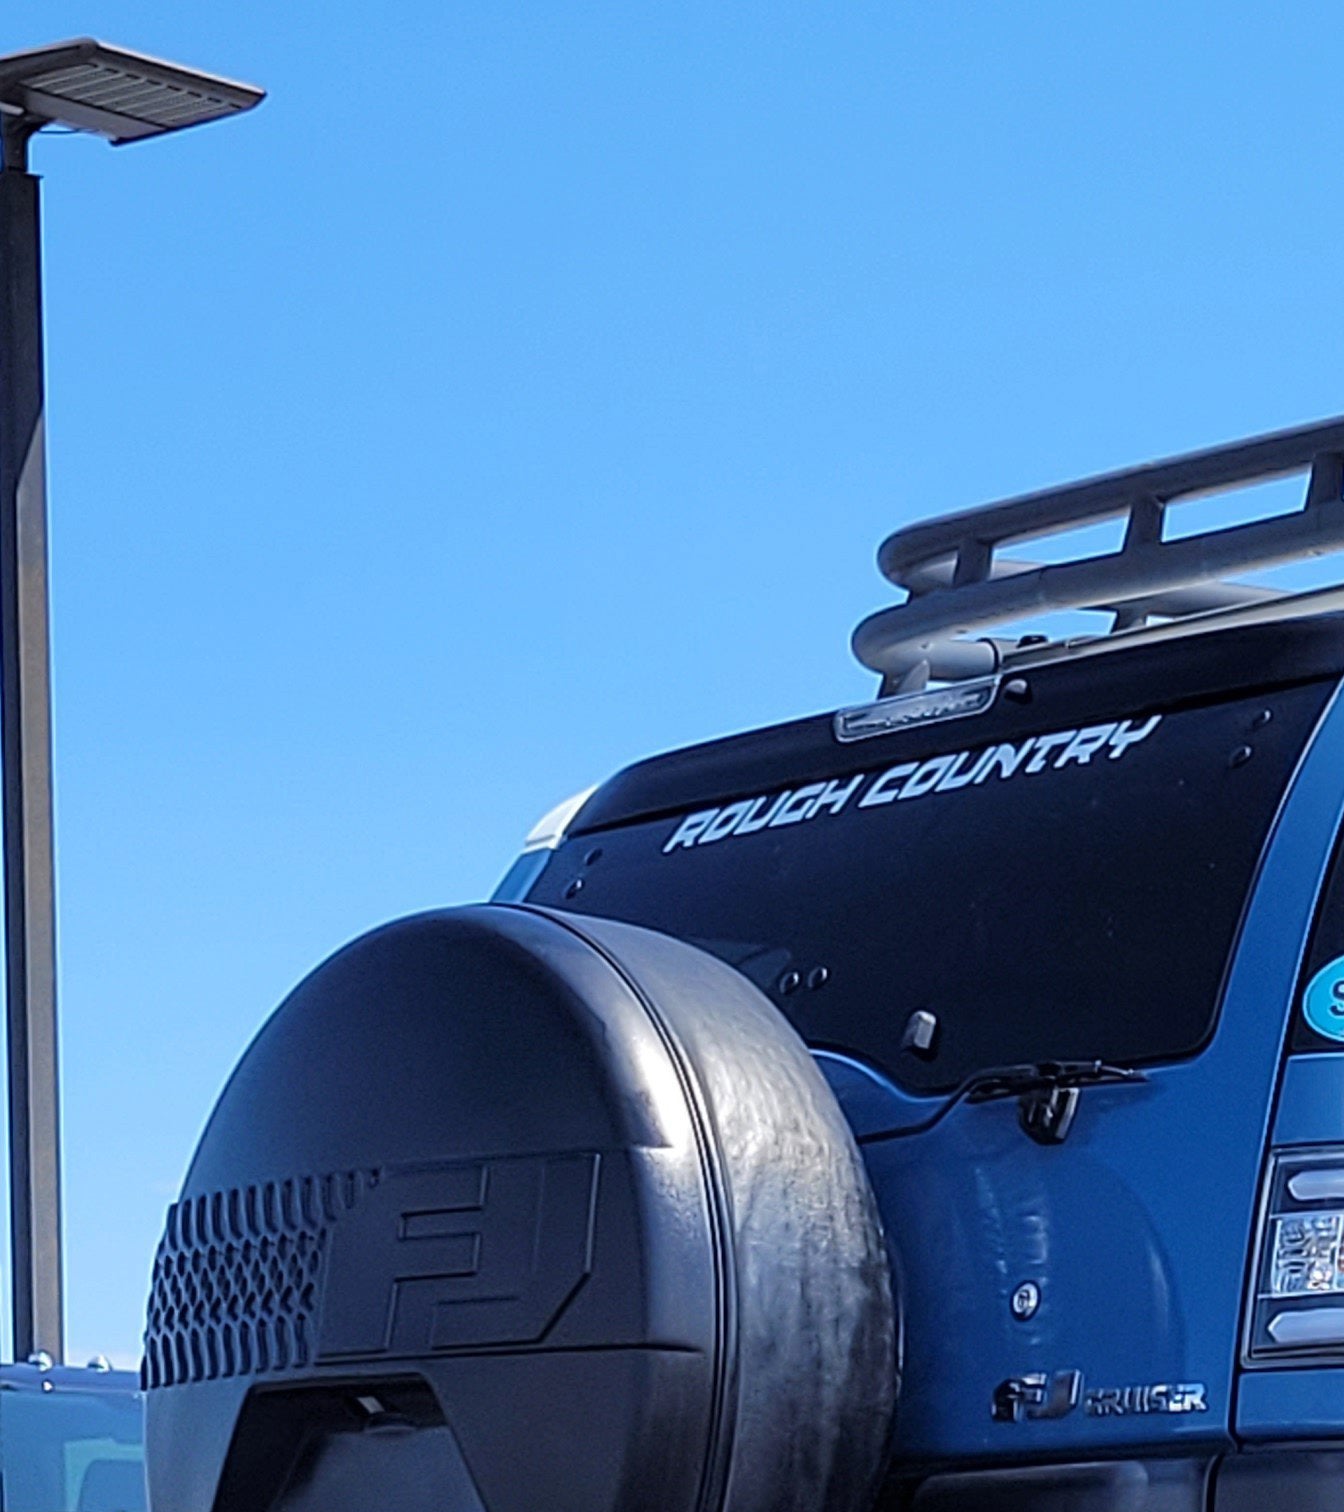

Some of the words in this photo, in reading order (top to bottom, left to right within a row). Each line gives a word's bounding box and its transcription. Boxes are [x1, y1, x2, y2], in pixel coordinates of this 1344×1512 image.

[661, 772, 866, 854] ROUGH
[857, 713, 1164, 809] COUNTRY
[992, 1368, 1084, 1423] FJ
